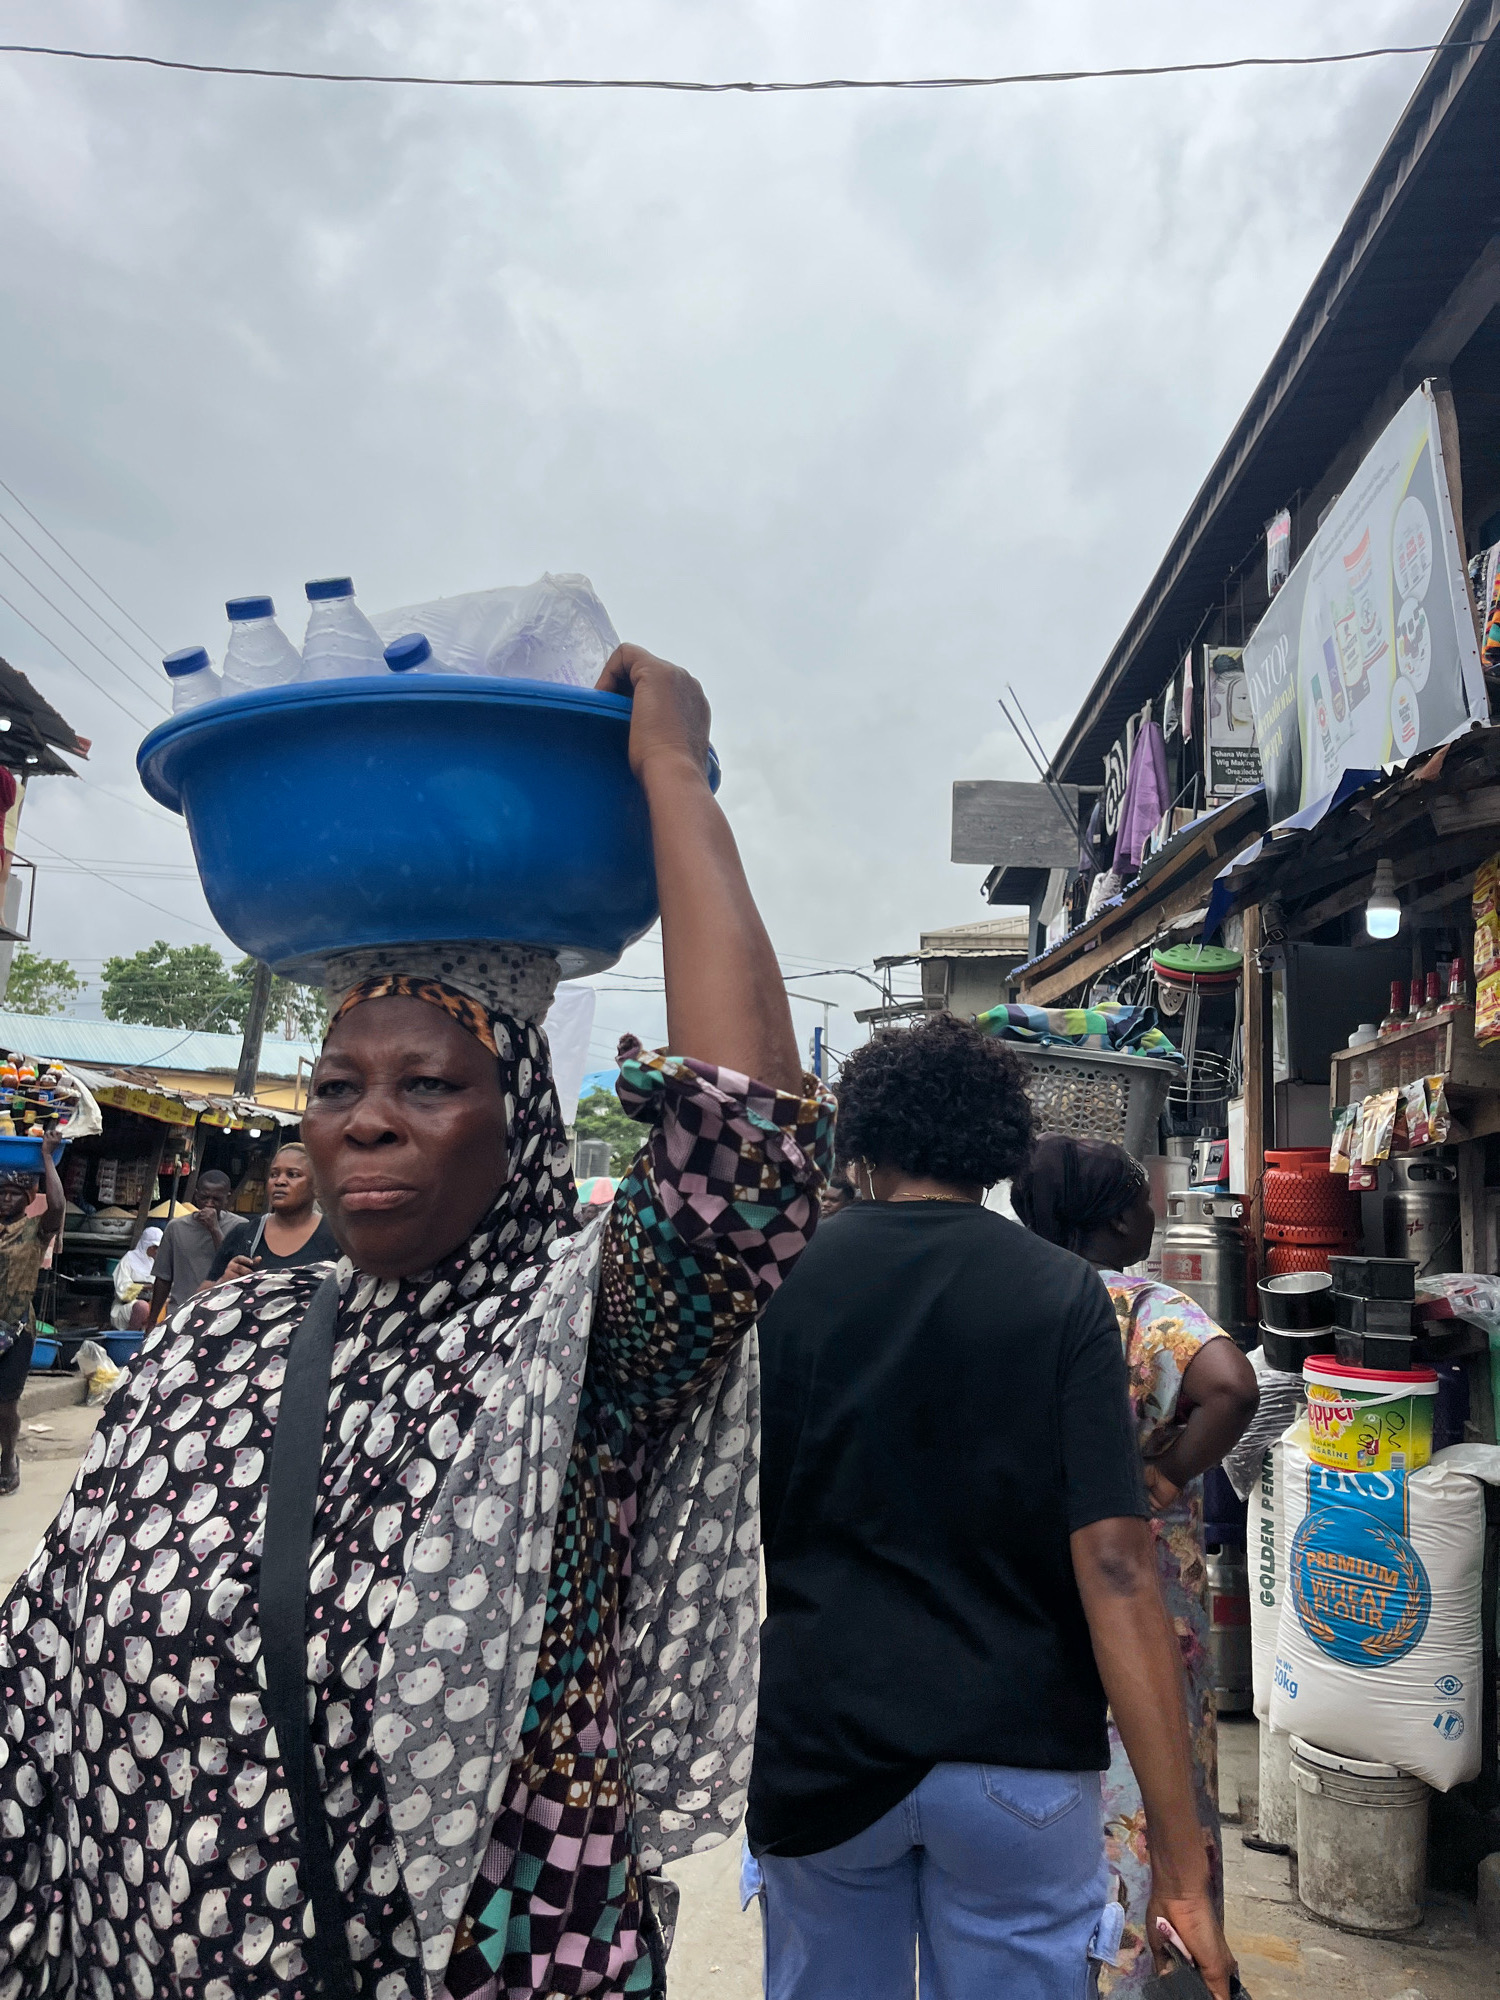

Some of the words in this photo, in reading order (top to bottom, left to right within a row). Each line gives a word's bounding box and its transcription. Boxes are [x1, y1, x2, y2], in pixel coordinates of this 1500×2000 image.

[1214, 750, 1235, 758] Ghana
[1216, 759, 1230, 768] Wig
[1308, 1399, 1357, 1431] opper
[1261, 1448, 1275, 1513] PENN
[1259, 1517, 1276, 1608] GOLDEN
[1306, 1550, 1400, 1587] PREMIUM
[1310, 1577, 1392, 1611] WHEAT
[1314, 1596, 1385, 1630] FLOUR
